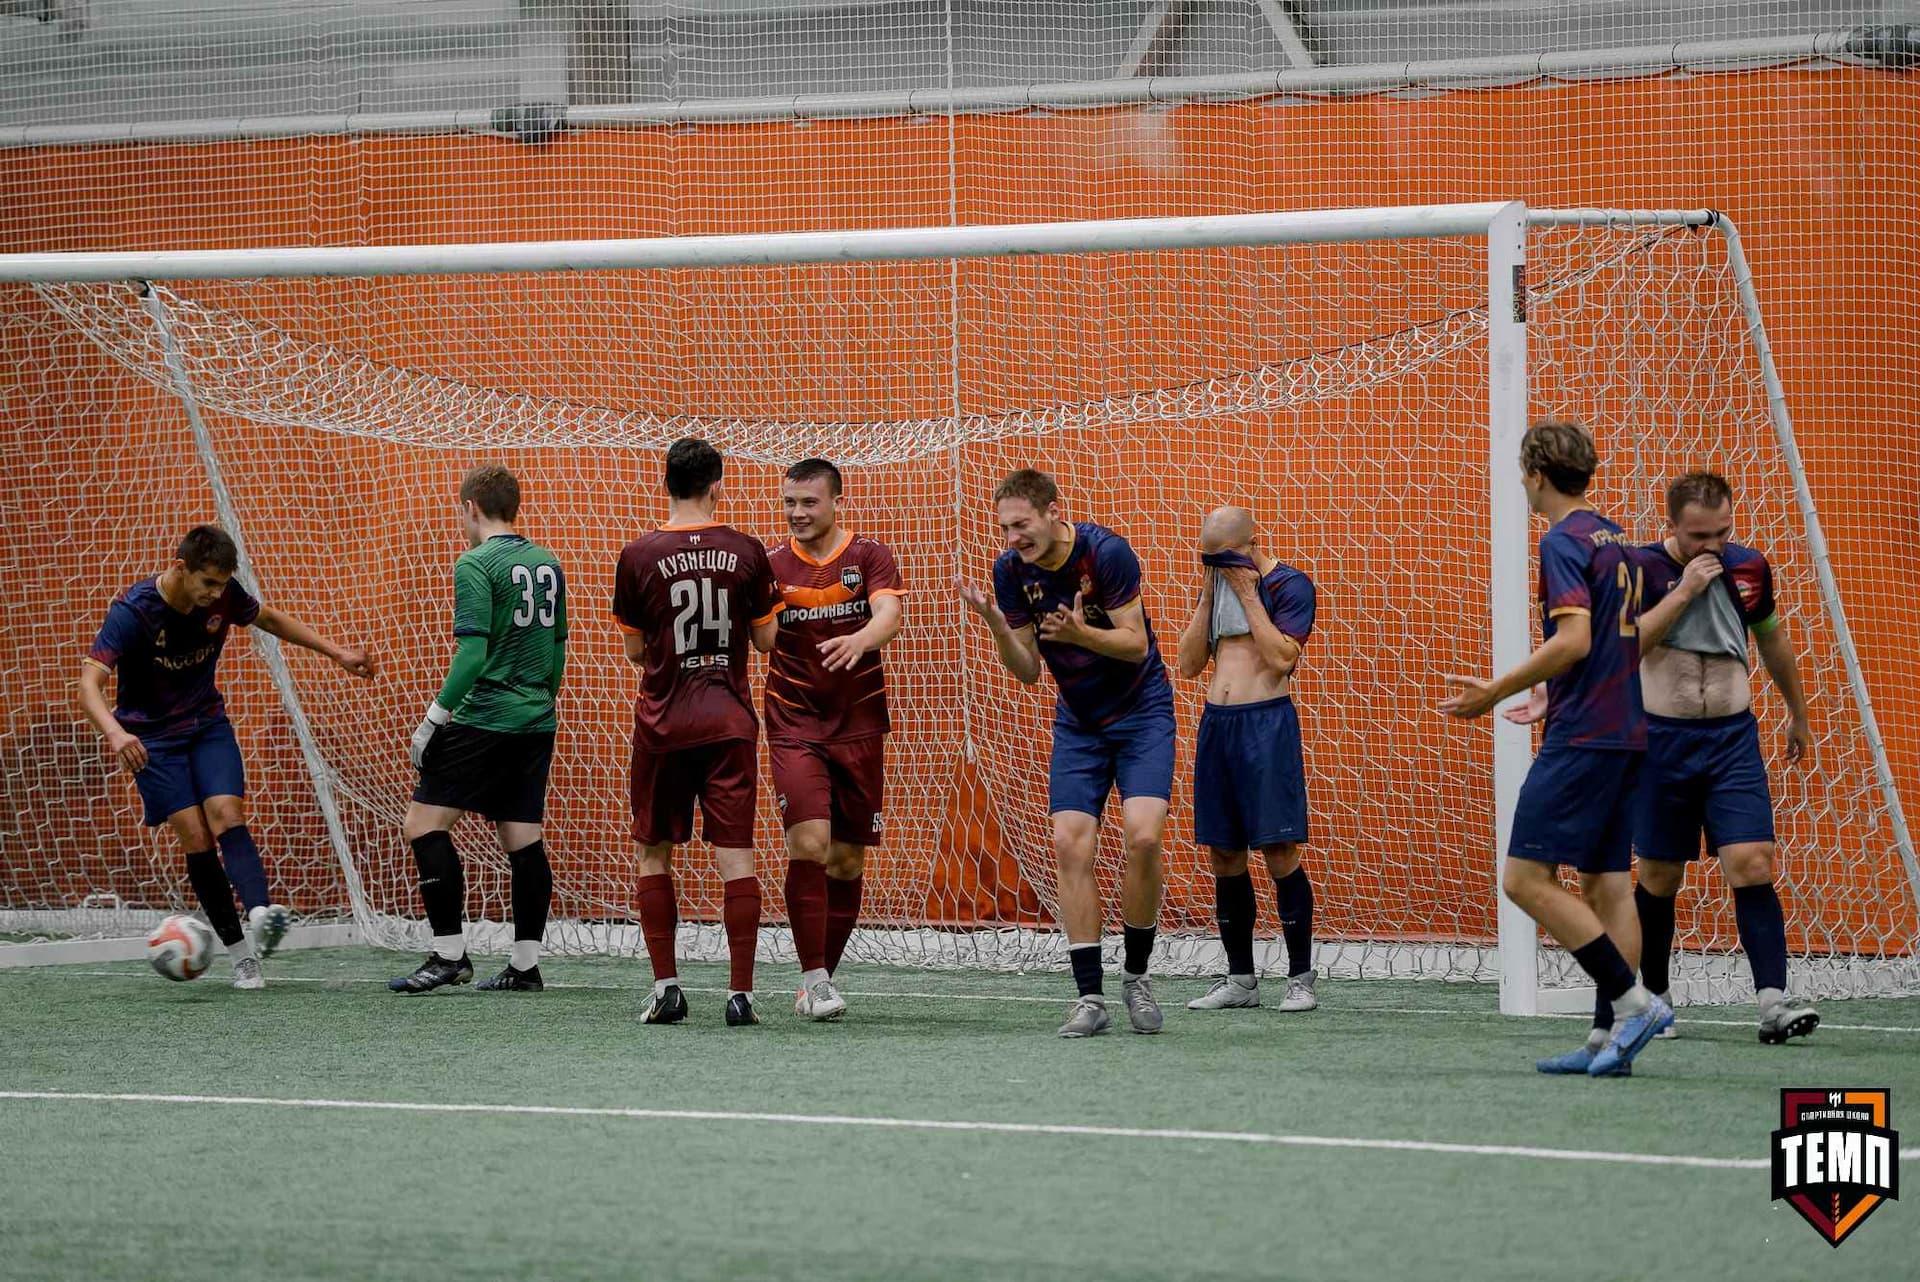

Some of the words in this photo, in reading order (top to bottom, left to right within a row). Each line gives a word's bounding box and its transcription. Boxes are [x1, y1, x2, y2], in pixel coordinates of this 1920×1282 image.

[657, 550, 738, 579] КУЗНЕЦОВ
[511, 564, 558, 627] 33
[670, 577, 732, 655] 24
[782, 600, 867, 624] ПРОДИНВЕСТ
[155, 628, 167, 649] 4
